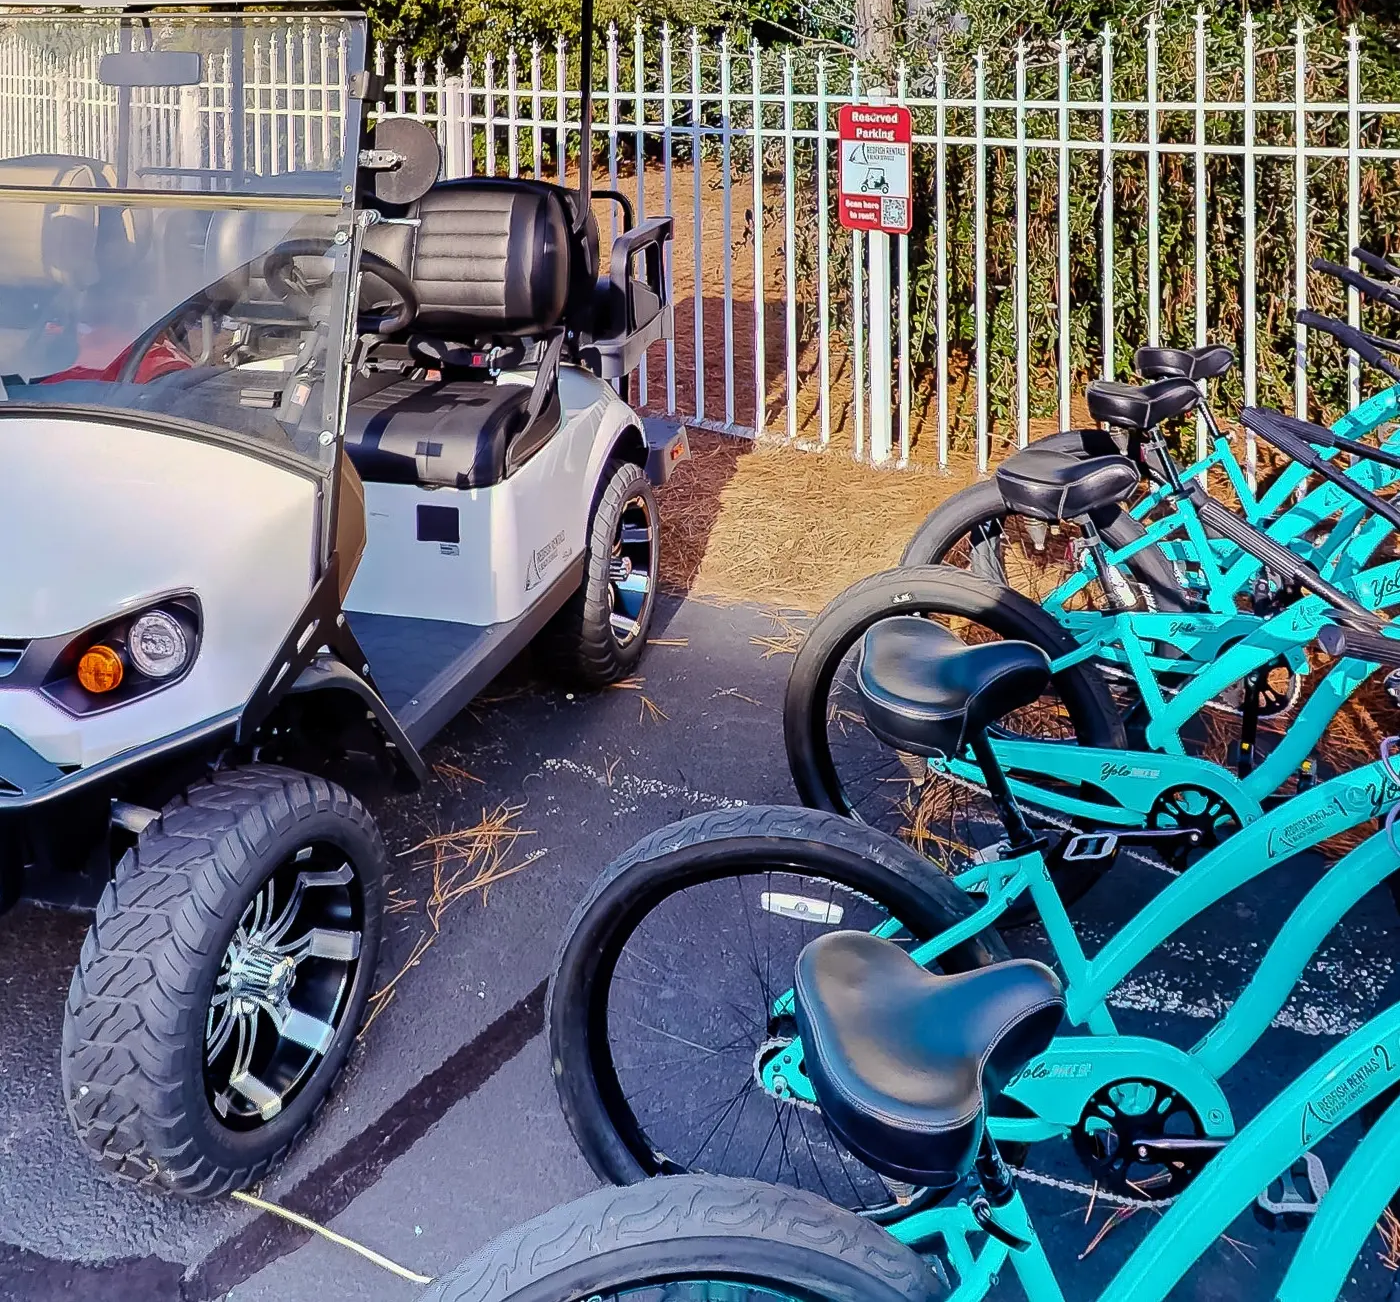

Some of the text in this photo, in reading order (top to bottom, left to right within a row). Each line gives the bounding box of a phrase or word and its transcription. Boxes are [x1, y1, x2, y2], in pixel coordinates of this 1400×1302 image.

[851, 111, 898, 124] Reserved
[856, 128, 895, 141] Parking
[886, 147, 906, 156] RENTALS
[1101, 762, 1131, 781] Yolo
[1316, 1082, 1350, 1113] REDFISH
[1346, 1057, 1380, 1089] RENTALS
